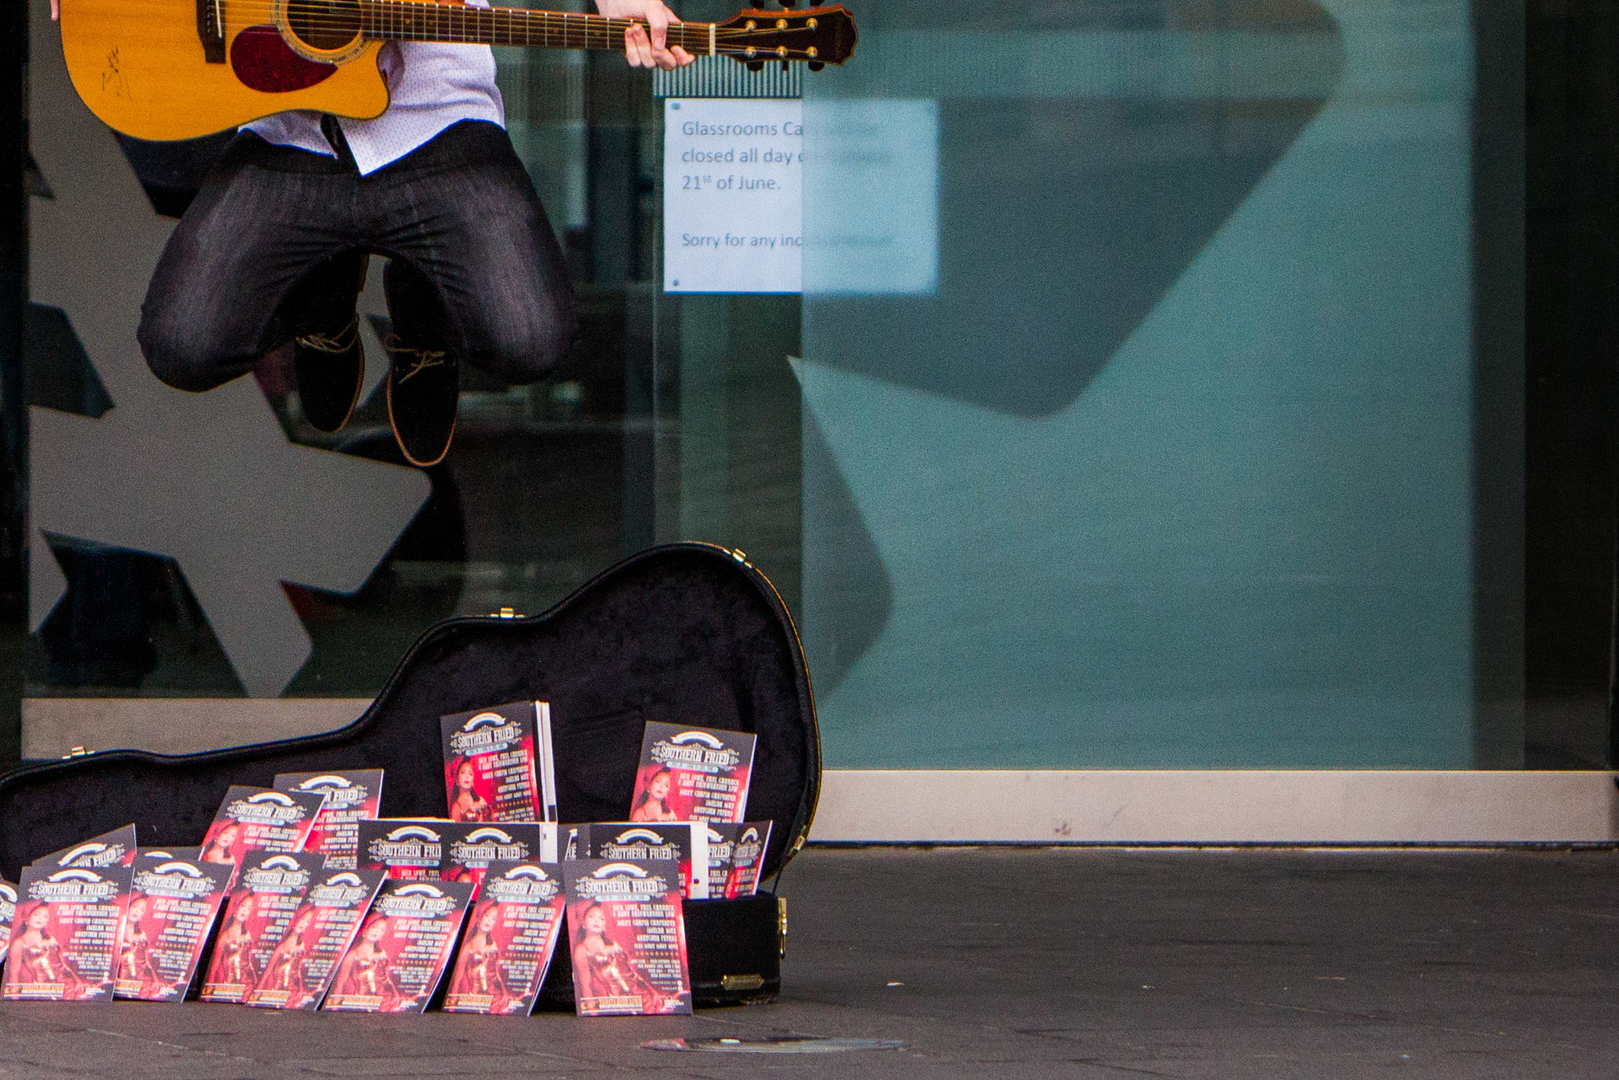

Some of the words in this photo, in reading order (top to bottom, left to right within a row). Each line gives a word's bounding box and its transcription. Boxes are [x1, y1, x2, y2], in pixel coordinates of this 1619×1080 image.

[682, 121, 778, 136] Glassrooms
[682, 148, 734, 163] closed
[739, 148, 758, 163] all
[763, 148, 793, 166] day
[717, 174, 734, 190] of
[737, 175, 781, 191] June.
[682, 233, 720, 249] Sorry
[725, 232, 746, 247] for
[750, 236, 776, 250] any
[458, 731, 492, 748] SOUTHERN
[494, 726, 515, 741] FRIED
[660, 746, 702, 763] SOUTHERN
[704, 750, 730, 765] FRIED
[234, 805, 275, 818] SOUTHERN
[275, 807, 298, 820] FRIED
[424, 845, 442, 858] FRI
[458, 846, 496, 859] SOUTHERN
[498, 846, 521, 859] FRIED
[608, 847, 647, 860] SOUTHERN
[649, 847, 672, 859] FRIED
[142, 875, 181, 889] SOUTHERN
[182, 877, 206, 891] FRIED
[251, 870, 280, 883] SOUTHERN
[282, 871, 303, 884] FRIED
[38, 884, 81, 895] SOUTHERN
[83, 884, 109, 896] FRIED
[493, 881, 528, 894] SOUTHERN
[529, 882, 552, 895] FRIED
[585, 880, 630, 894] SOUTHERN
[632, 880, 658, 894] FRIED
[381, 897, 421, 910] SOUTHERN
[422, 899, 448, 911] FRIED
